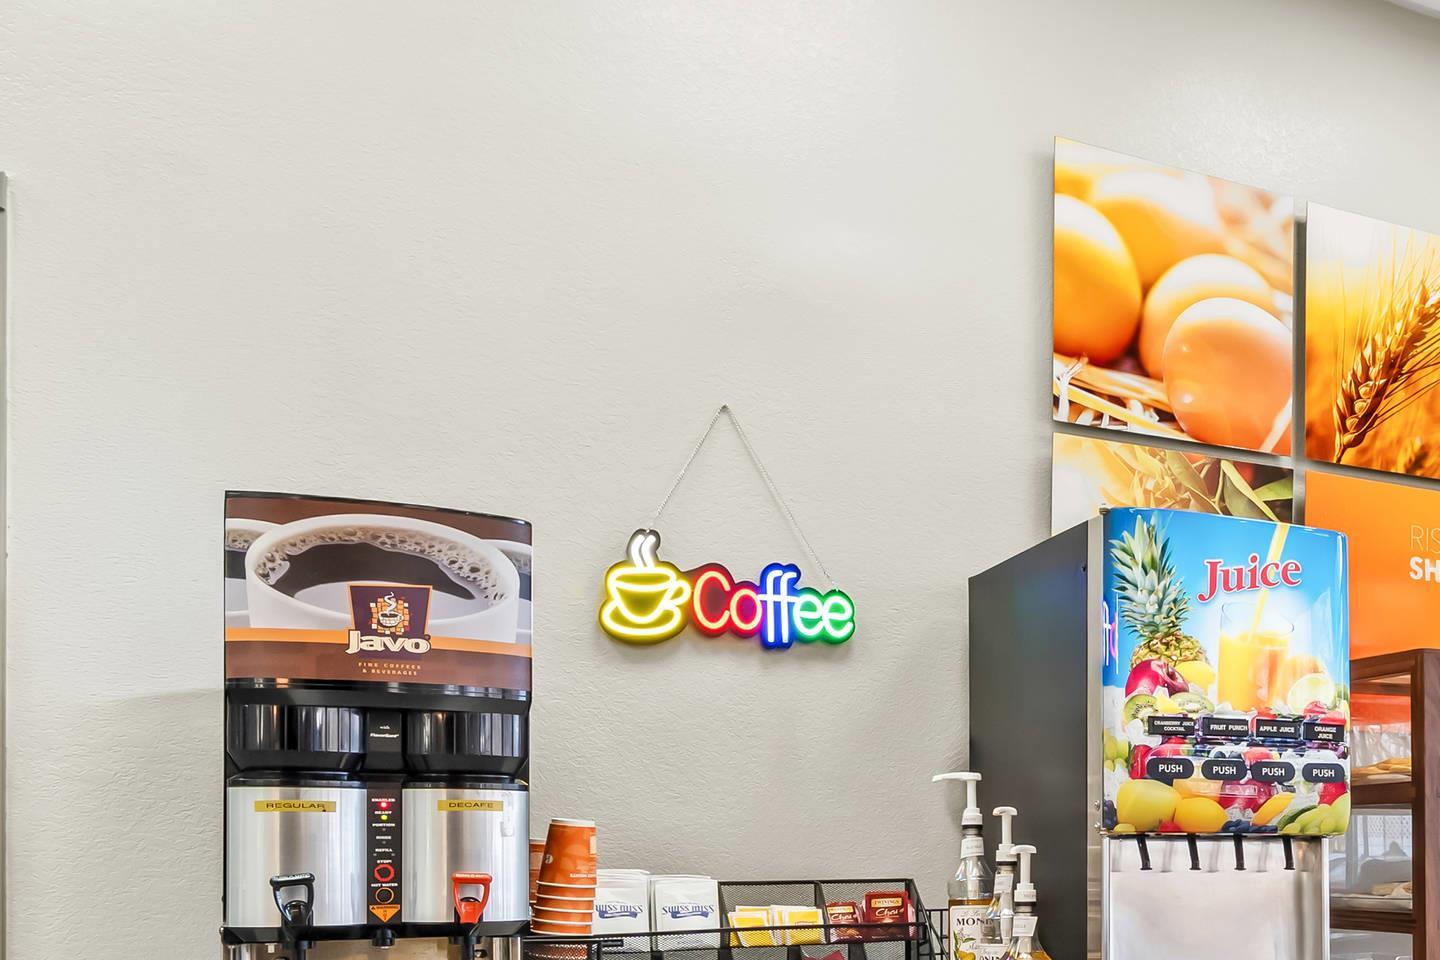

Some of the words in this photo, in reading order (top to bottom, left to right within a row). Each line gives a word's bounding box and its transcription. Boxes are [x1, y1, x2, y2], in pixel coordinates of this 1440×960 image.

[1197, 554, 1302, 602] Juice
[692, 566, 854, 645] Coffee
[1158, 764, 1183, 773] PUSH
[1212, 766, 1237, 775] PUSH
[1261, 767, 1285, 776] PUSH
[1312, 769, 1335, 777] PUSH
